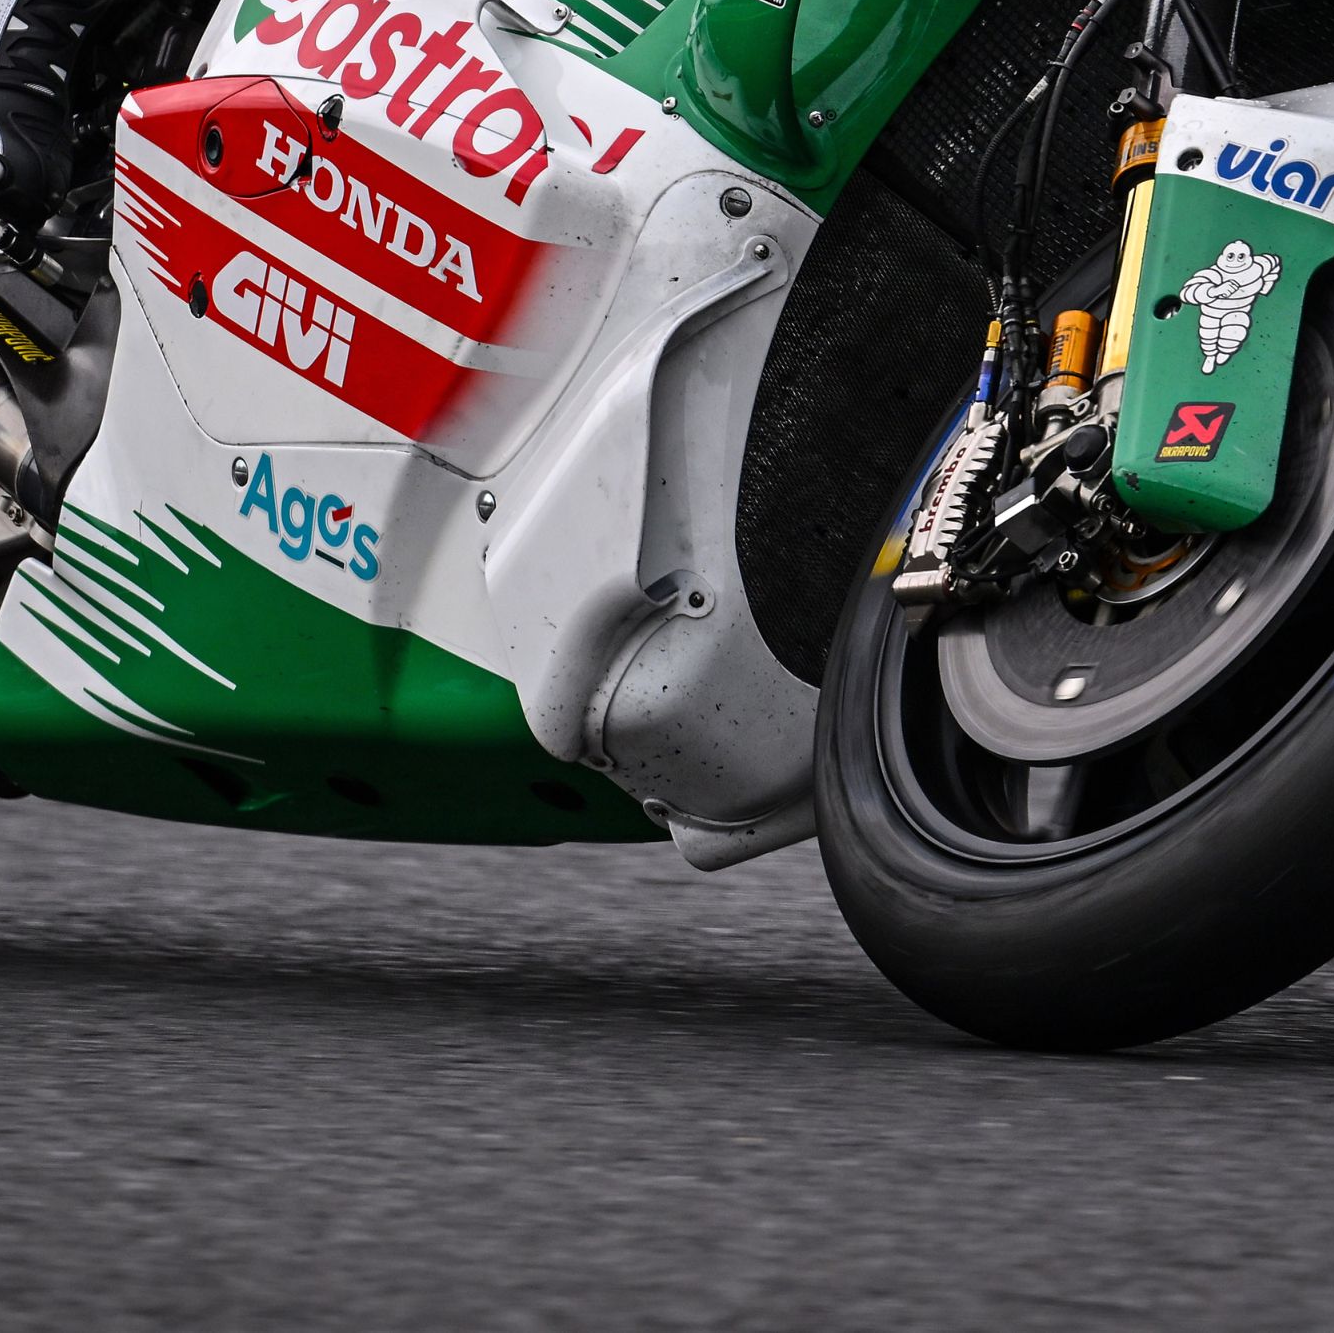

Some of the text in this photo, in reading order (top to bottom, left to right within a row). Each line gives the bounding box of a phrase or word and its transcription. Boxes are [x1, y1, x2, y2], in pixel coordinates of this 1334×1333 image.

[256, 120, 483, 303] HONDA
[211, 251, 356, 388] GIVI
[239, 453, 379, 581] Agos
[918, 446, 967, 533] brembo
